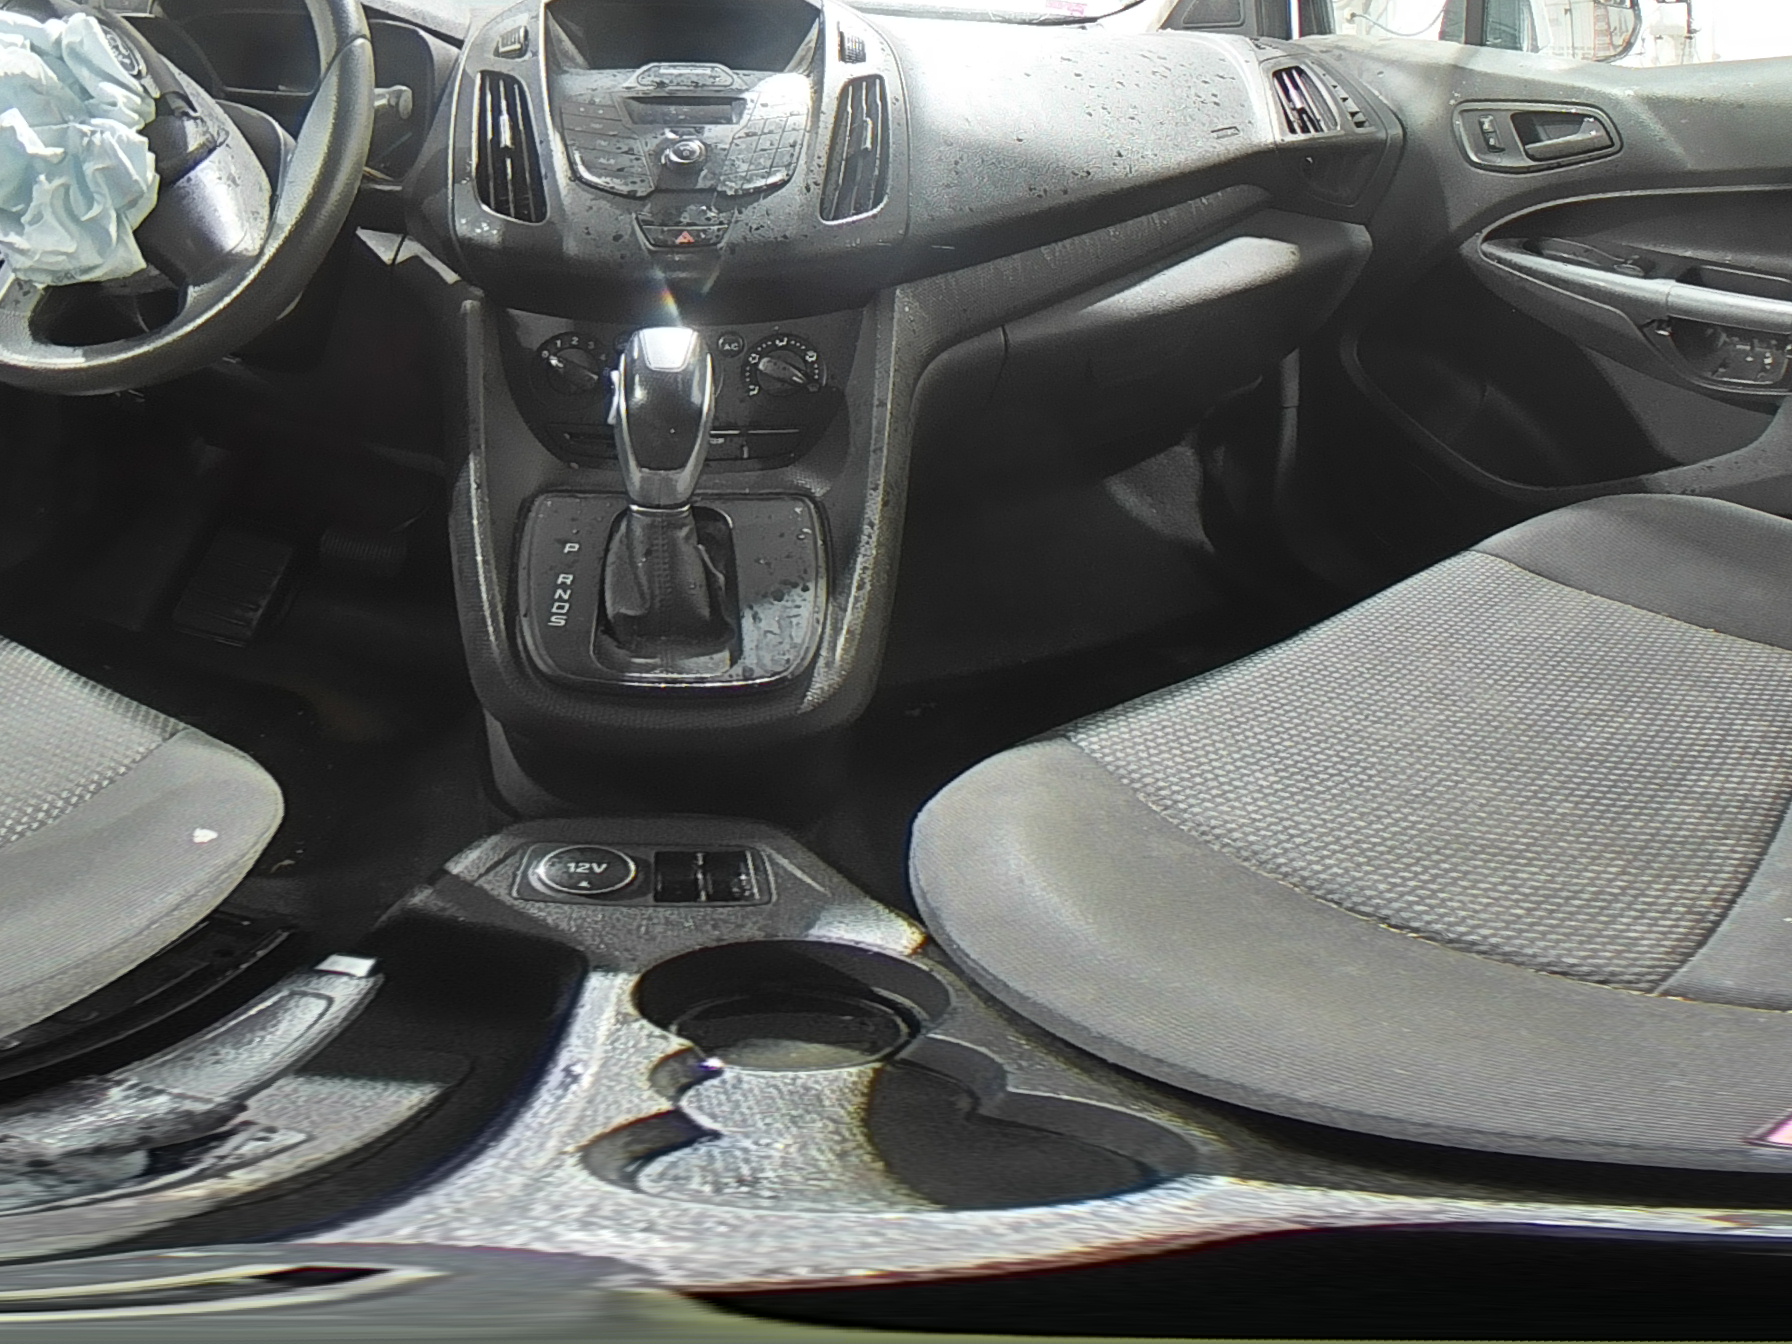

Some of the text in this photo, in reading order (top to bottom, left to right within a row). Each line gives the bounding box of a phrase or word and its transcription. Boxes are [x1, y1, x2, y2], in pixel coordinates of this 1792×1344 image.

[555, 339, 562, 348] 1
[571, 336, 579, 345] 2
[587, 341, 595, 350] 3
[563, 543, 579, 554] P
[556, 574, 573, 585] R
[554, 588, 571, 600] N
[551, 602, 570, 614] D
[547, 615, 568, 627] S
[566, 862, 608, 874] 12V
